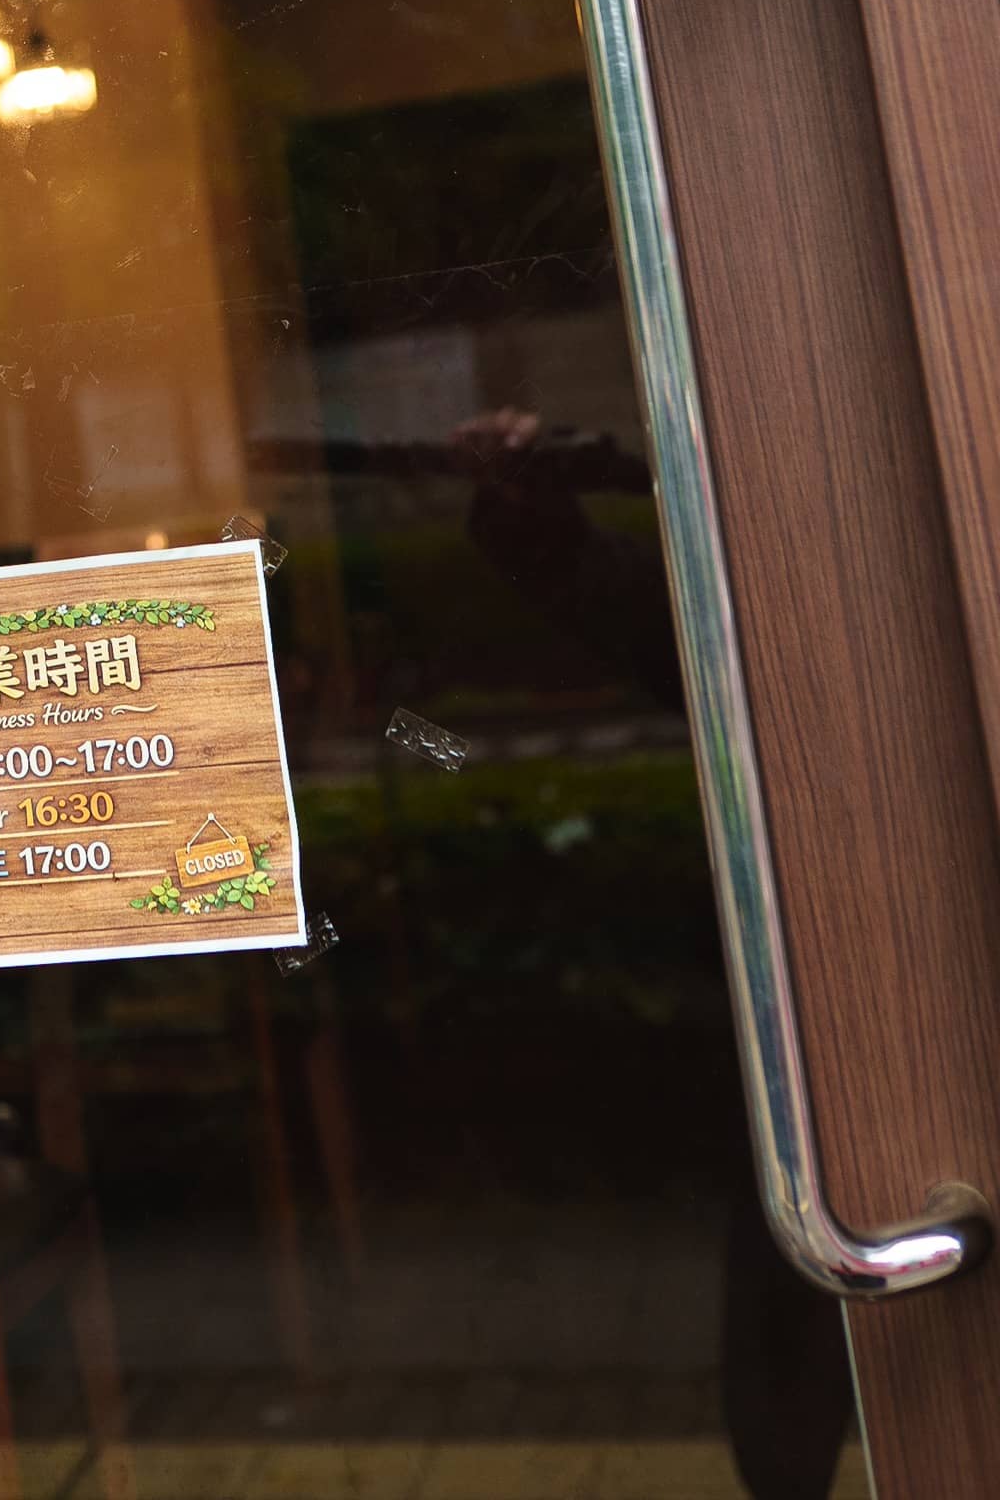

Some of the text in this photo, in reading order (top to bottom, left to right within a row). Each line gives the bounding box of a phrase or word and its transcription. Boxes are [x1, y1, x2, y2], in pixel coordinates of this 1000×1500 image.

[41, 702, 104, 726] Hours
[17, 791, 115, 829] 16:30
[18, 841, 112, 876] 17:00
[185, 849, 246, 877] CLOSED
